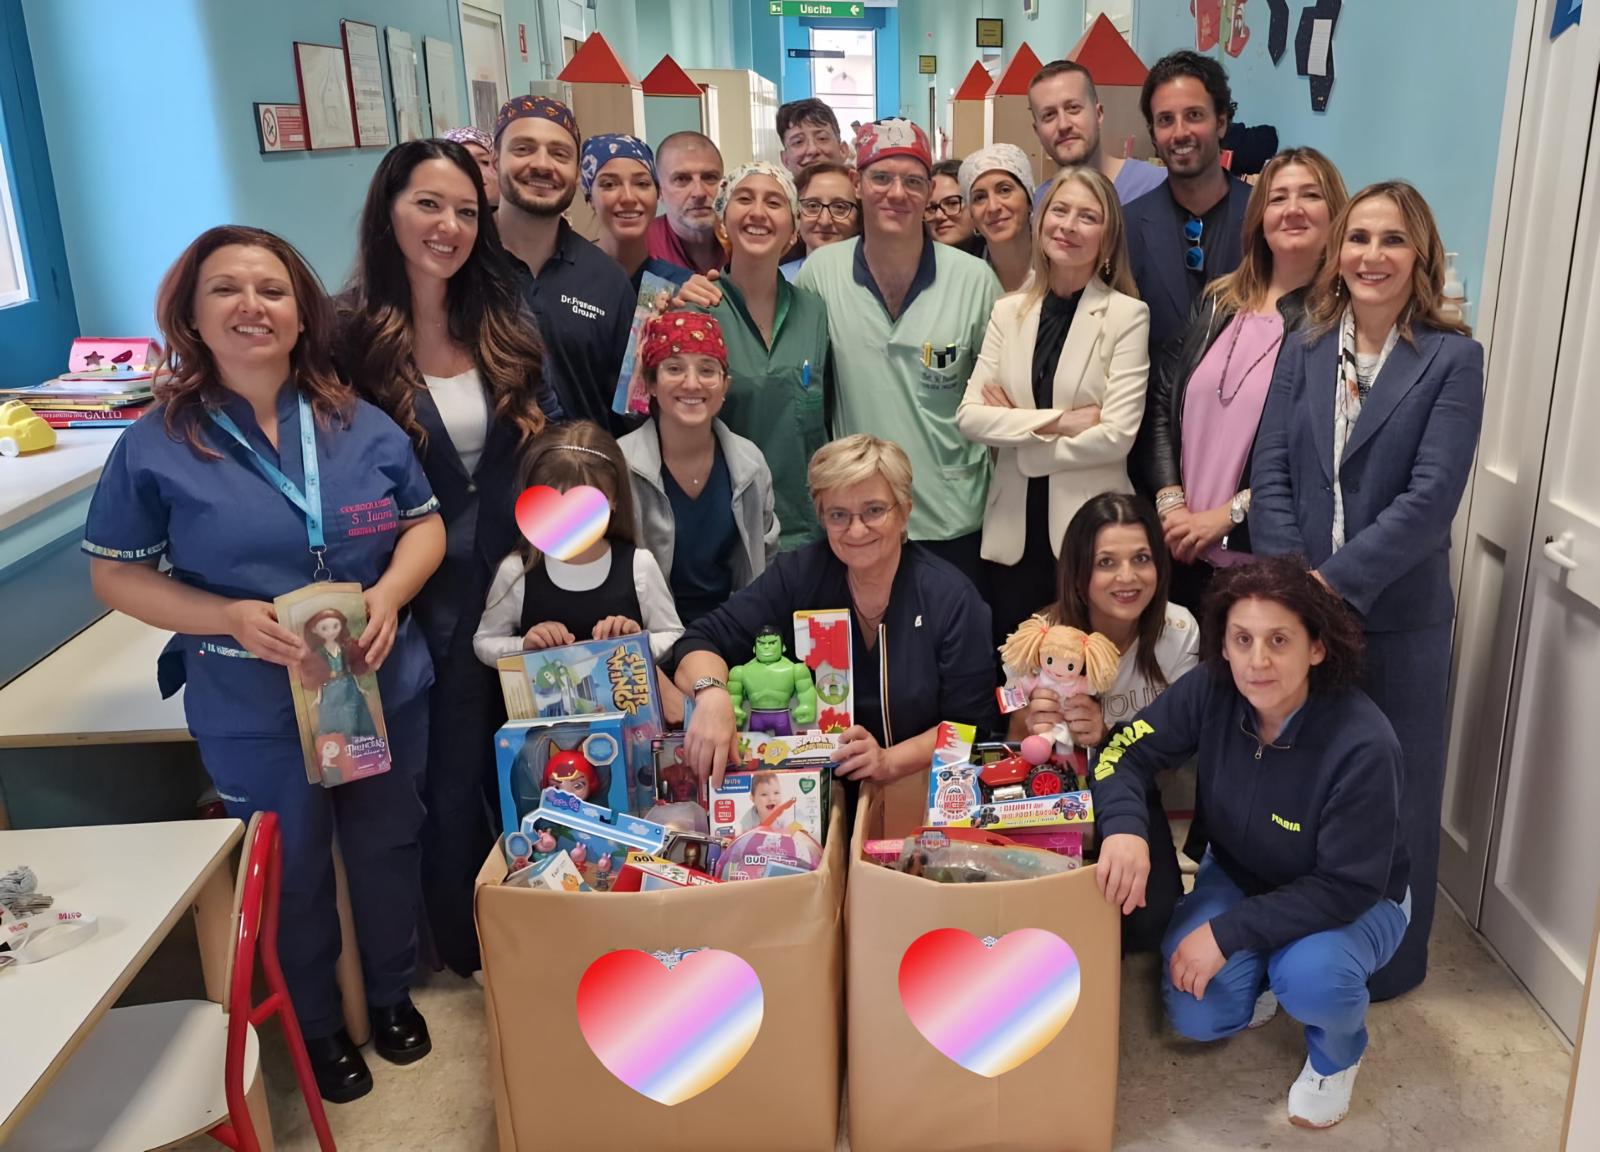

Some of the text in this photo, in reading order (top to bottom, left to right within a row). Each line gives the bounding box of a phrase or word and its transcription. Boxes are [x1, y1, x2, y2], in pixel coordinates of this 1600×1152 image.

[800, 4, 832, 14] Uscita
[607, 645, 637, 716] WINGS
[624, 652, 649, 705] SUPER
[633, 855, 655, 863] 100
